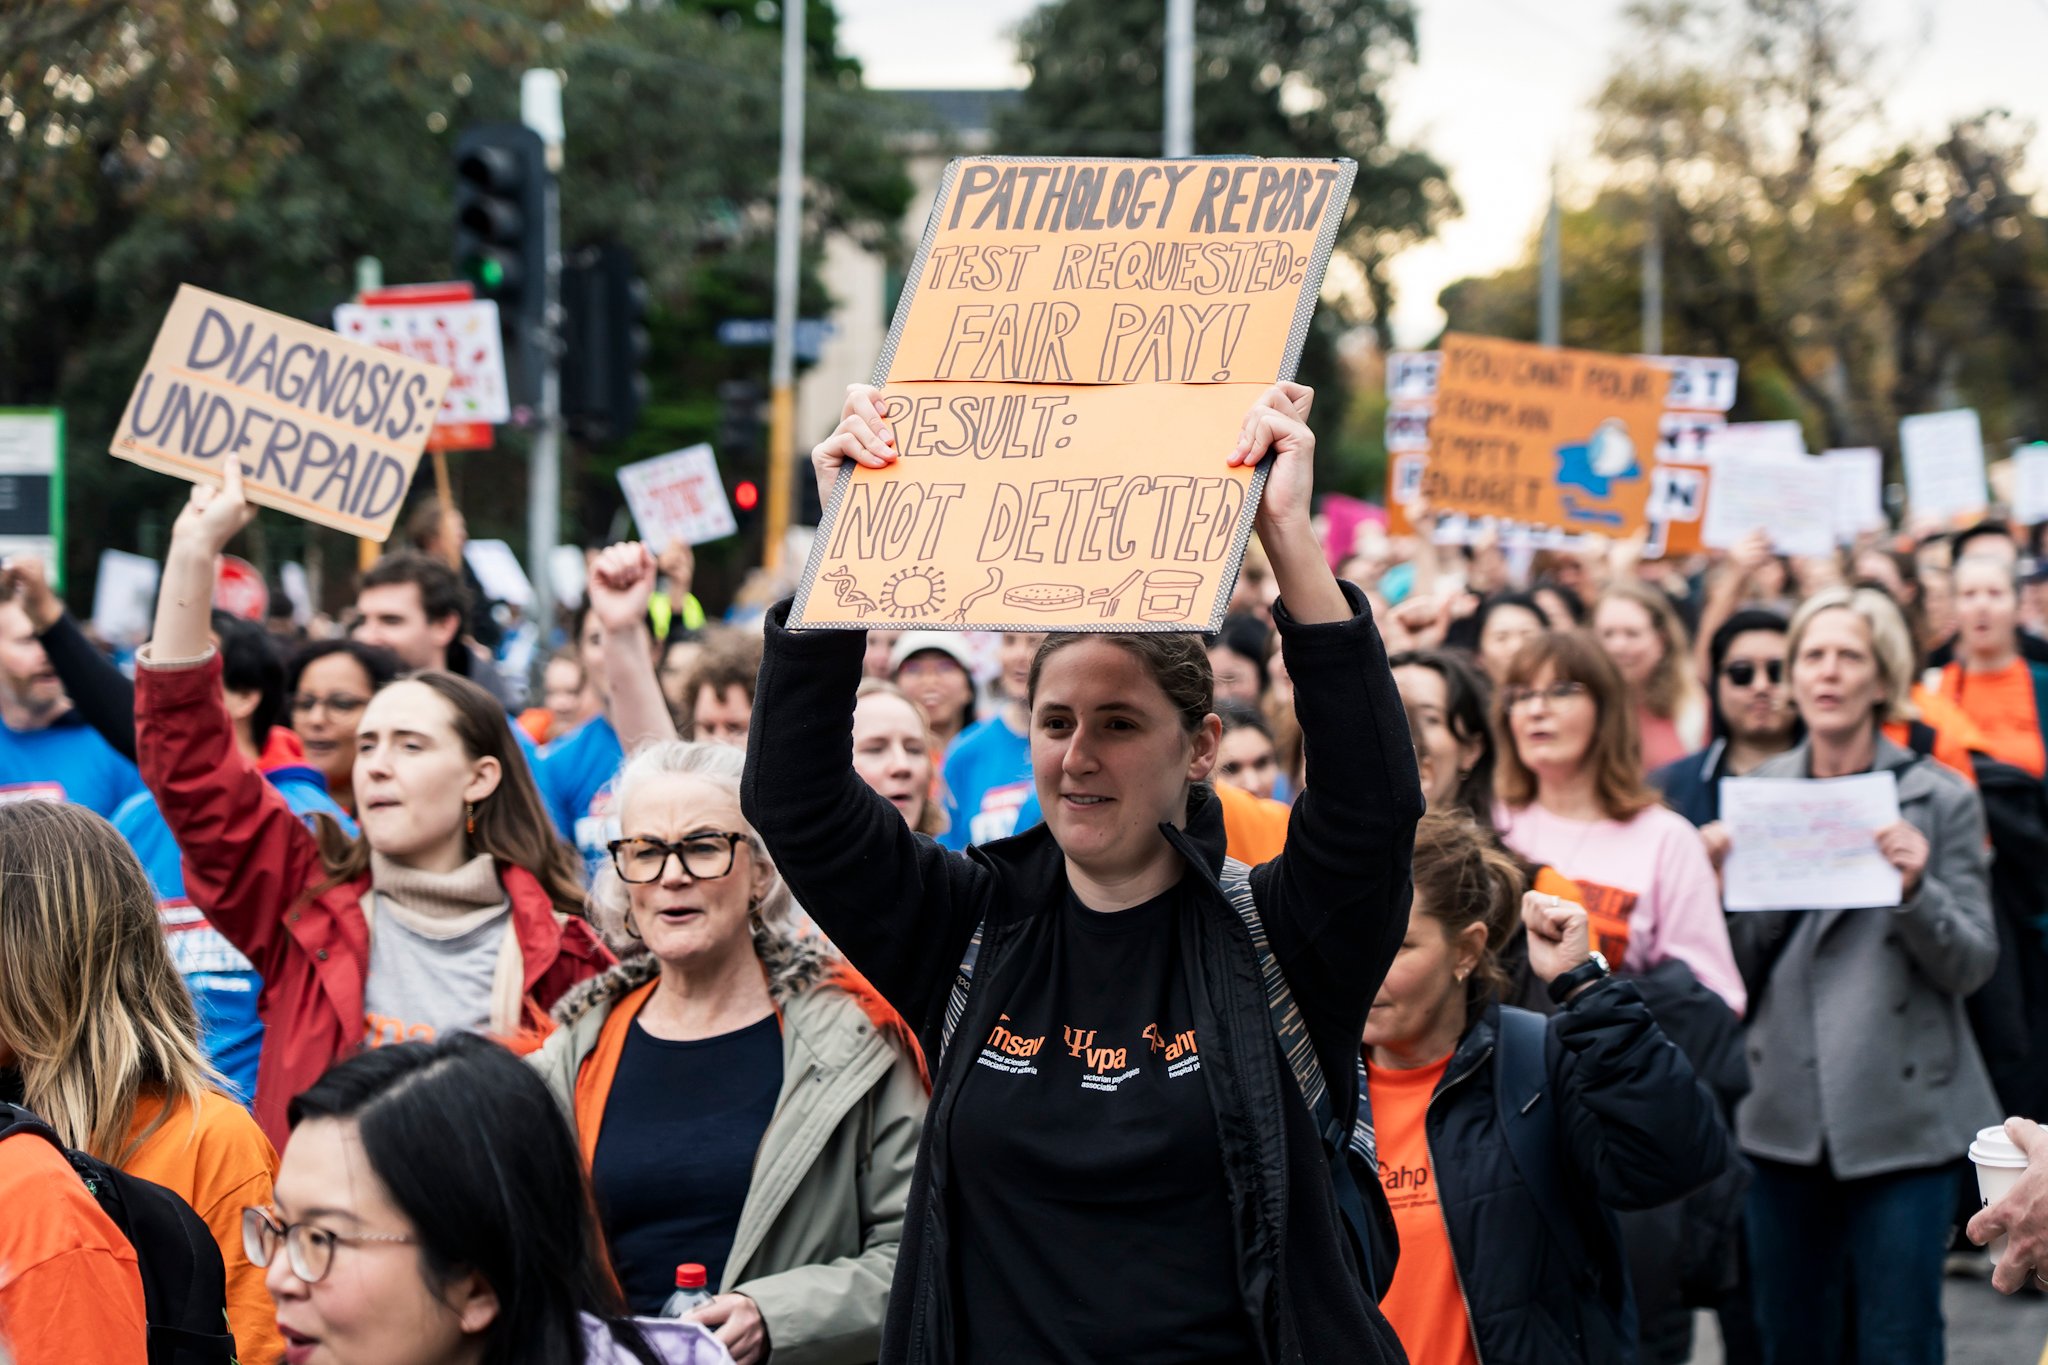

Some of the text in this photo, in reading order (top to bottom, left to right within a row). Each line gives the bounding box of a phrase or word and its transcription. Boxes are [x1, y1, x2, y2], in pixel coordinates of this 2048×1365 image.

[948, 164, 1340, 234] PATHOLOGY REPORT
[929, 240, 1308, 295] TEST REQUESTED:
[934, 301, 1251, 383] FAIR PAY!
[187, 307, 436, 440] DIAGNOSIS:
[131, 372, 405, 520] UNDERPAID
[882, 394, 1078, 460] RESULT:
[830, 475, 1245, 563] NOT DETECTED
[987, 1025, 1046, 1058] msav
[1085, 1046, 1127, 1075] vpa
[1081, 1081, 1118, 1092] association
[1082, 1073, 1112, 1084] victorian
[1168, 1064, 1194, 1079] hospital
[1385, 1165, 1428, 1191] ahp
